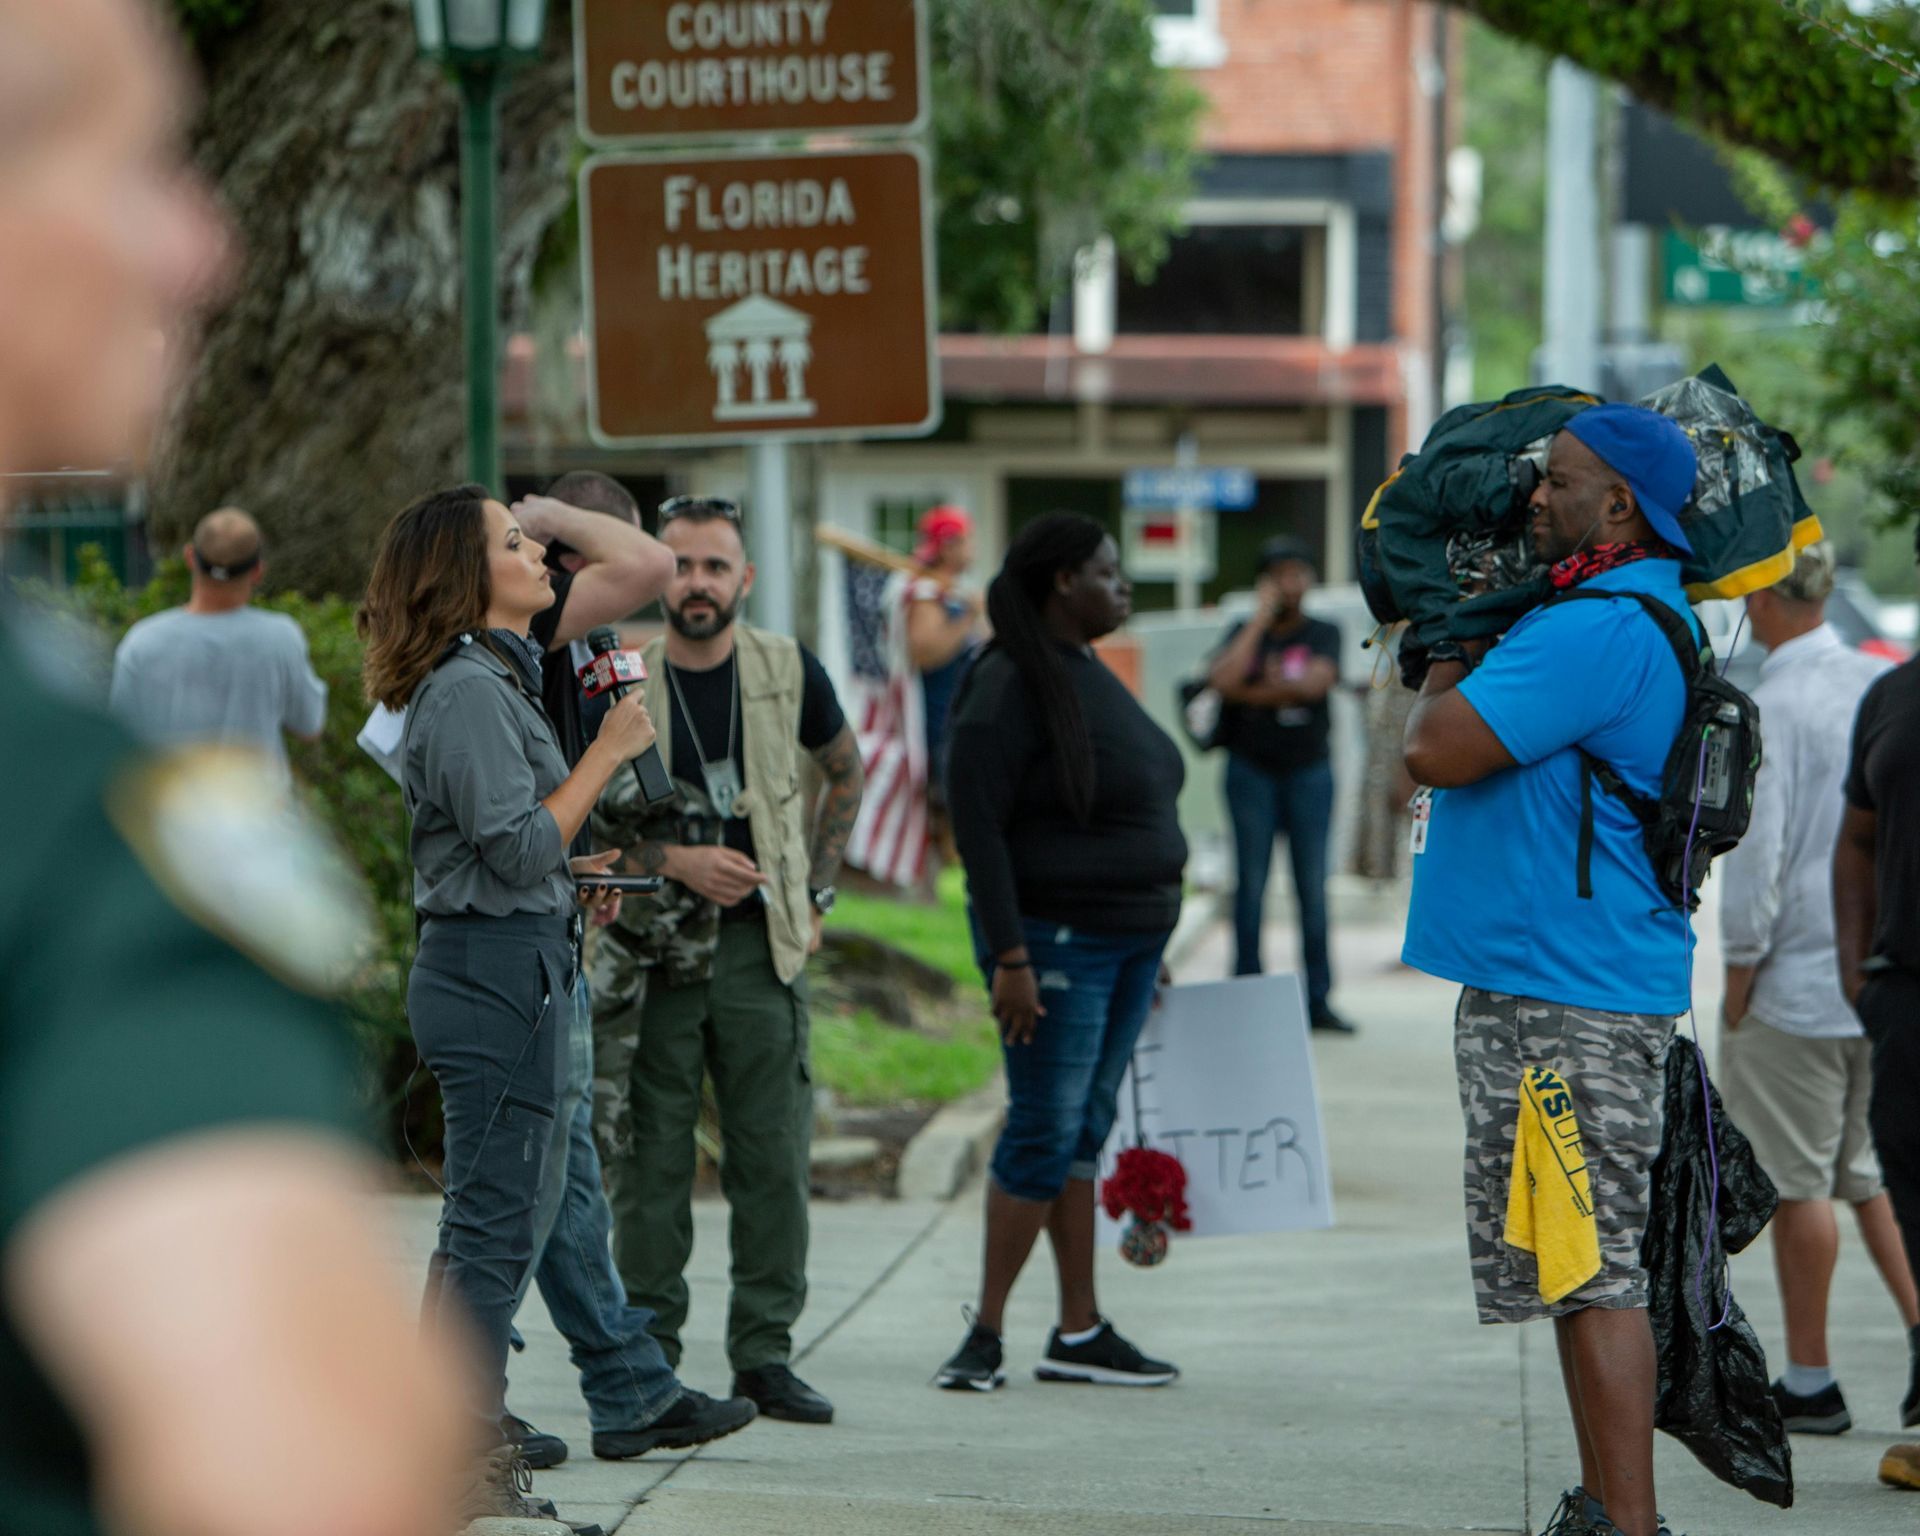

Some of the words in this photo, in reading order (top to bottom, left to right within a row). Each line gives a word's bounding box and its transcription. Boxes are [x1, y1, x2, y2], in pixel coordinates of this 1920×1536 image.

[667, 2, 832, 50] COUNTY
[612, 53, 893, 109] COURTHOUSE
[664, 175, 854, 231] FLORIDA
[658, 244, 869, 299] HERITAGE
[1140, 1116, 1318, 1205] TTER
